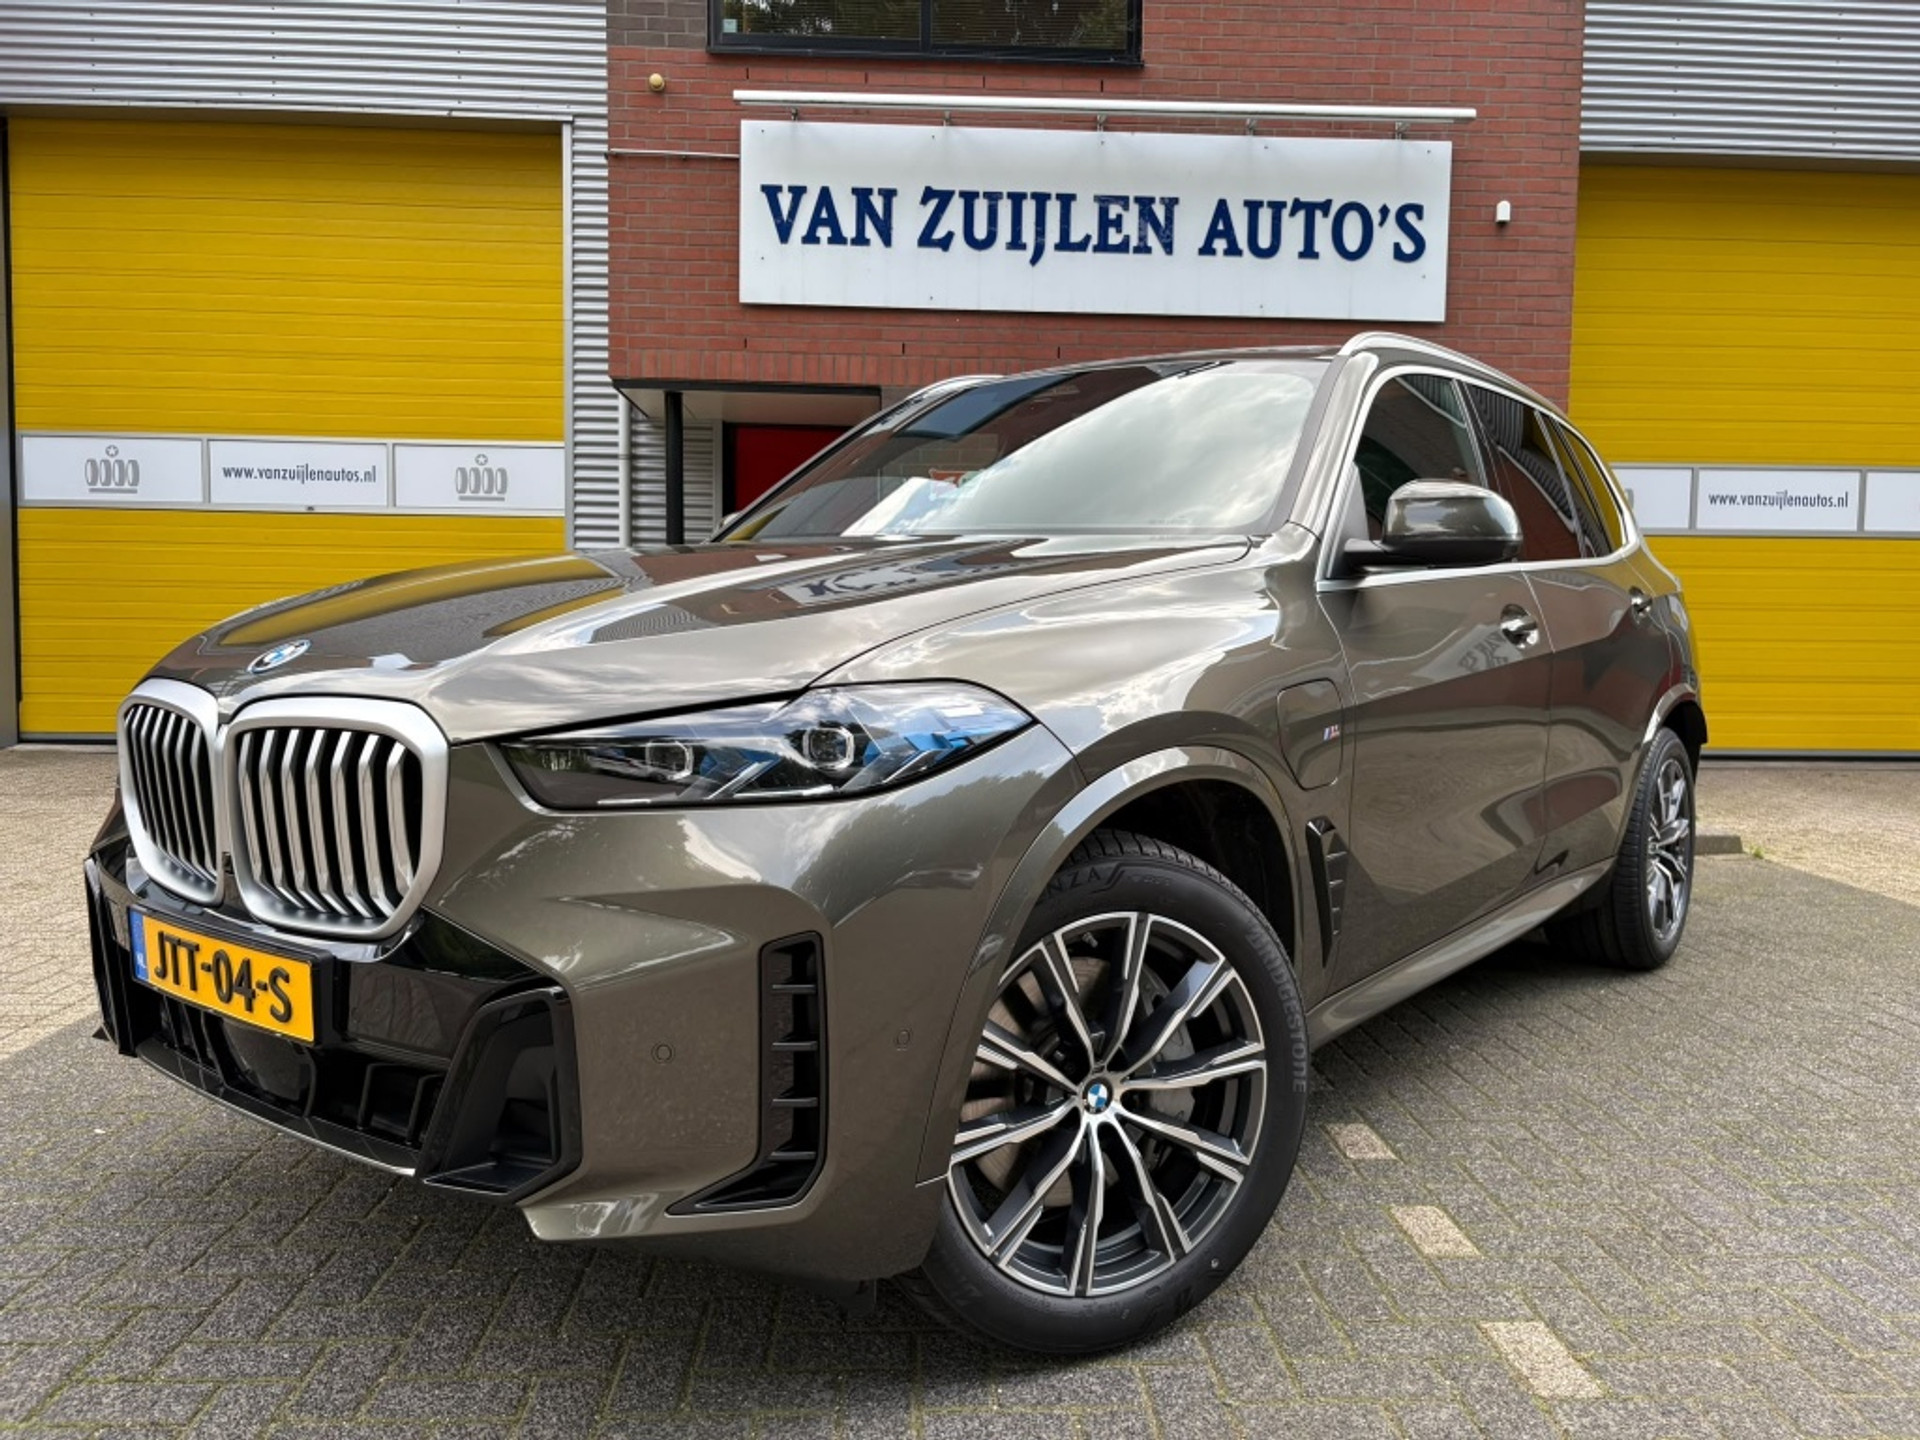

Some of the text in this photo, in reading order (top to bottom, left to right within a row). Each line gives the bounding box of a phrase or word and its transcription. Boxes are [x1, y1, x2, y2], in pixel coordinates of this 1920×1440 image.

[760, 184, 1426, 267] VAN ZUIJLEN AUTO'S
[222, 463, 377, 484] www.vanzuijlenautos.nl
[1708, 490, 1849, 510] www.vanzuijlenautos.nl
[154, 931, 293, 1023] JTT-04-S
